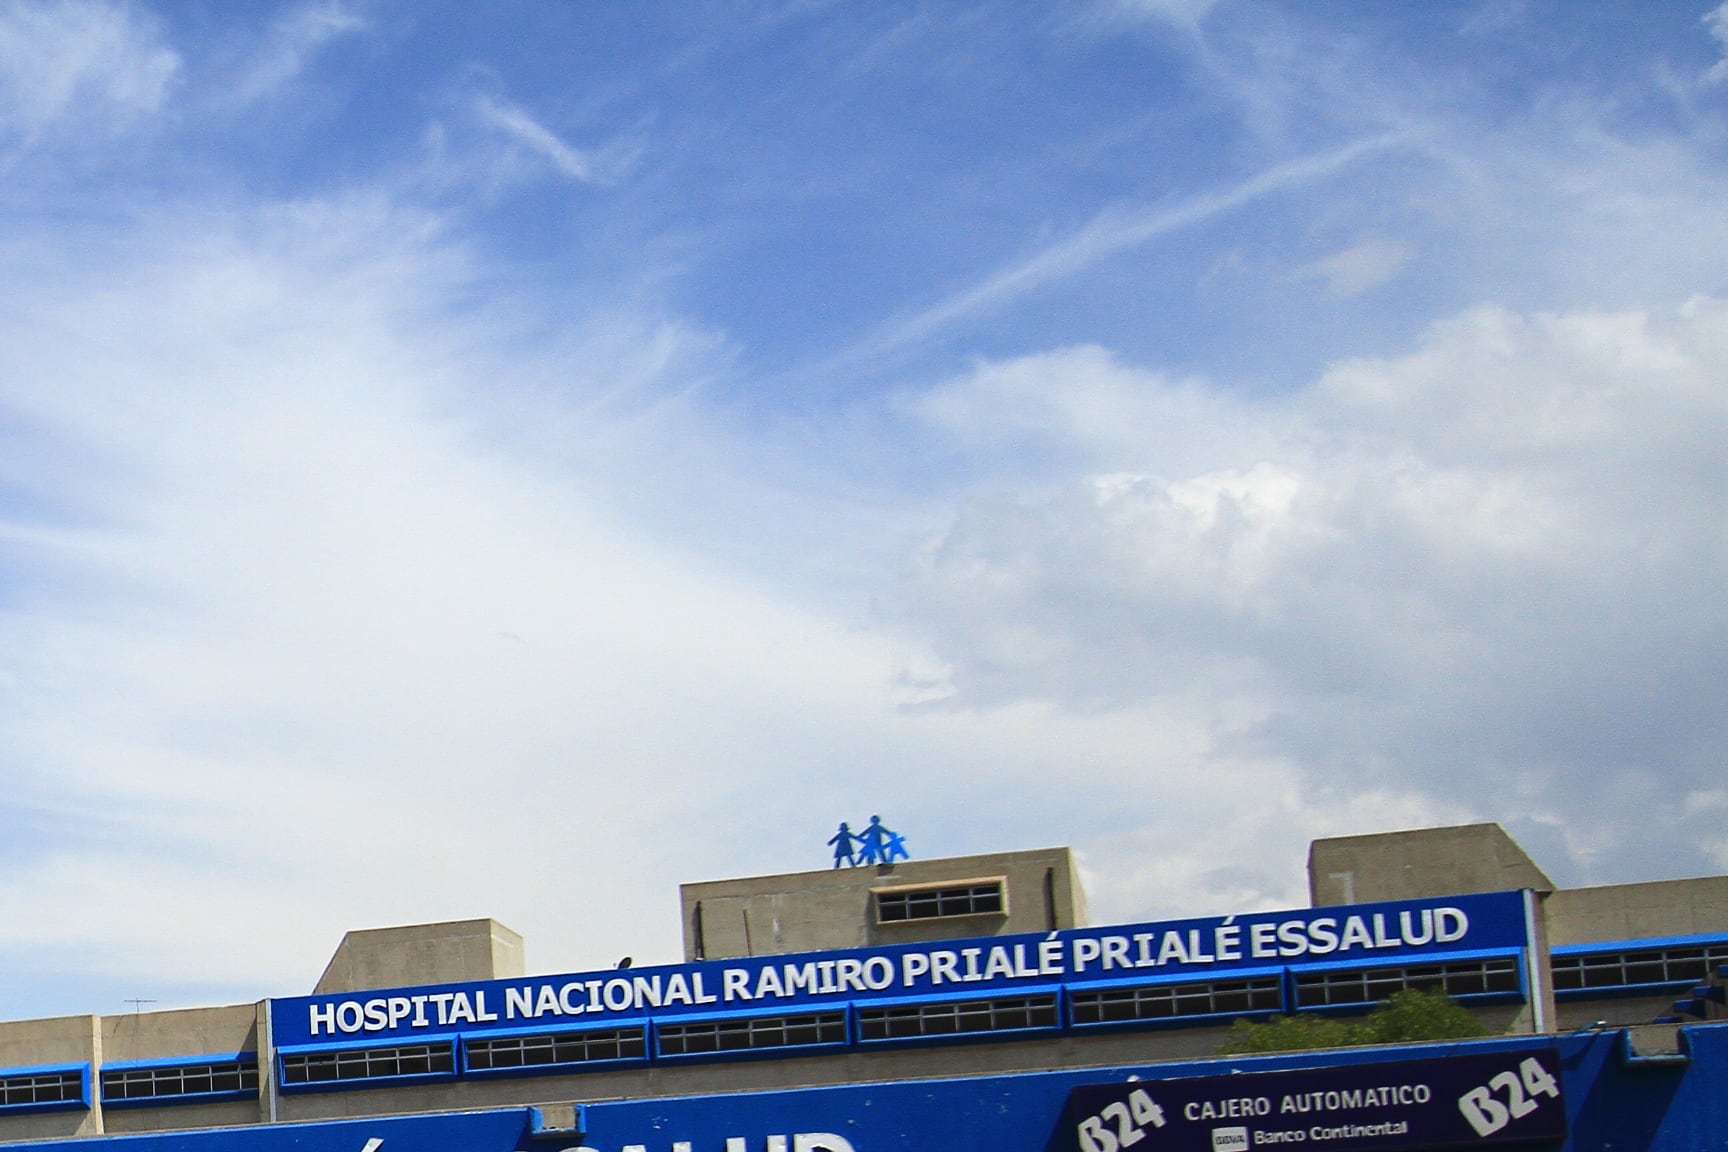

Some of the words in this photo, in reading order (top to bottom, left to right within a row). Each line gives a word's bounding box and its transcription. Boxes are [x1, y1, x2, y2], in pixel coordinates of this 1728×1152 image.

[310, 990, 497, 1035] HOSPITAL
[506, 973, 716, 1019] NACIONAL
[724, 956, 894, 1001] RAMIRO
[903, 930, 1065, 986] PRIALÉ
[1074, 916, 1242, 972] PRIALÉ
[1251, 907, 1469, 958] ESSALUD
[1184, 1096, 1271, 1121] CAJERO
[1281, 1084, 1431, 1114] AUTOMATICO
[1458, 1057, 1560, 1137] B24
[1254, 1129, 1306, 1145] Banco
[1309, 1120, 1408, 1141] Continental
